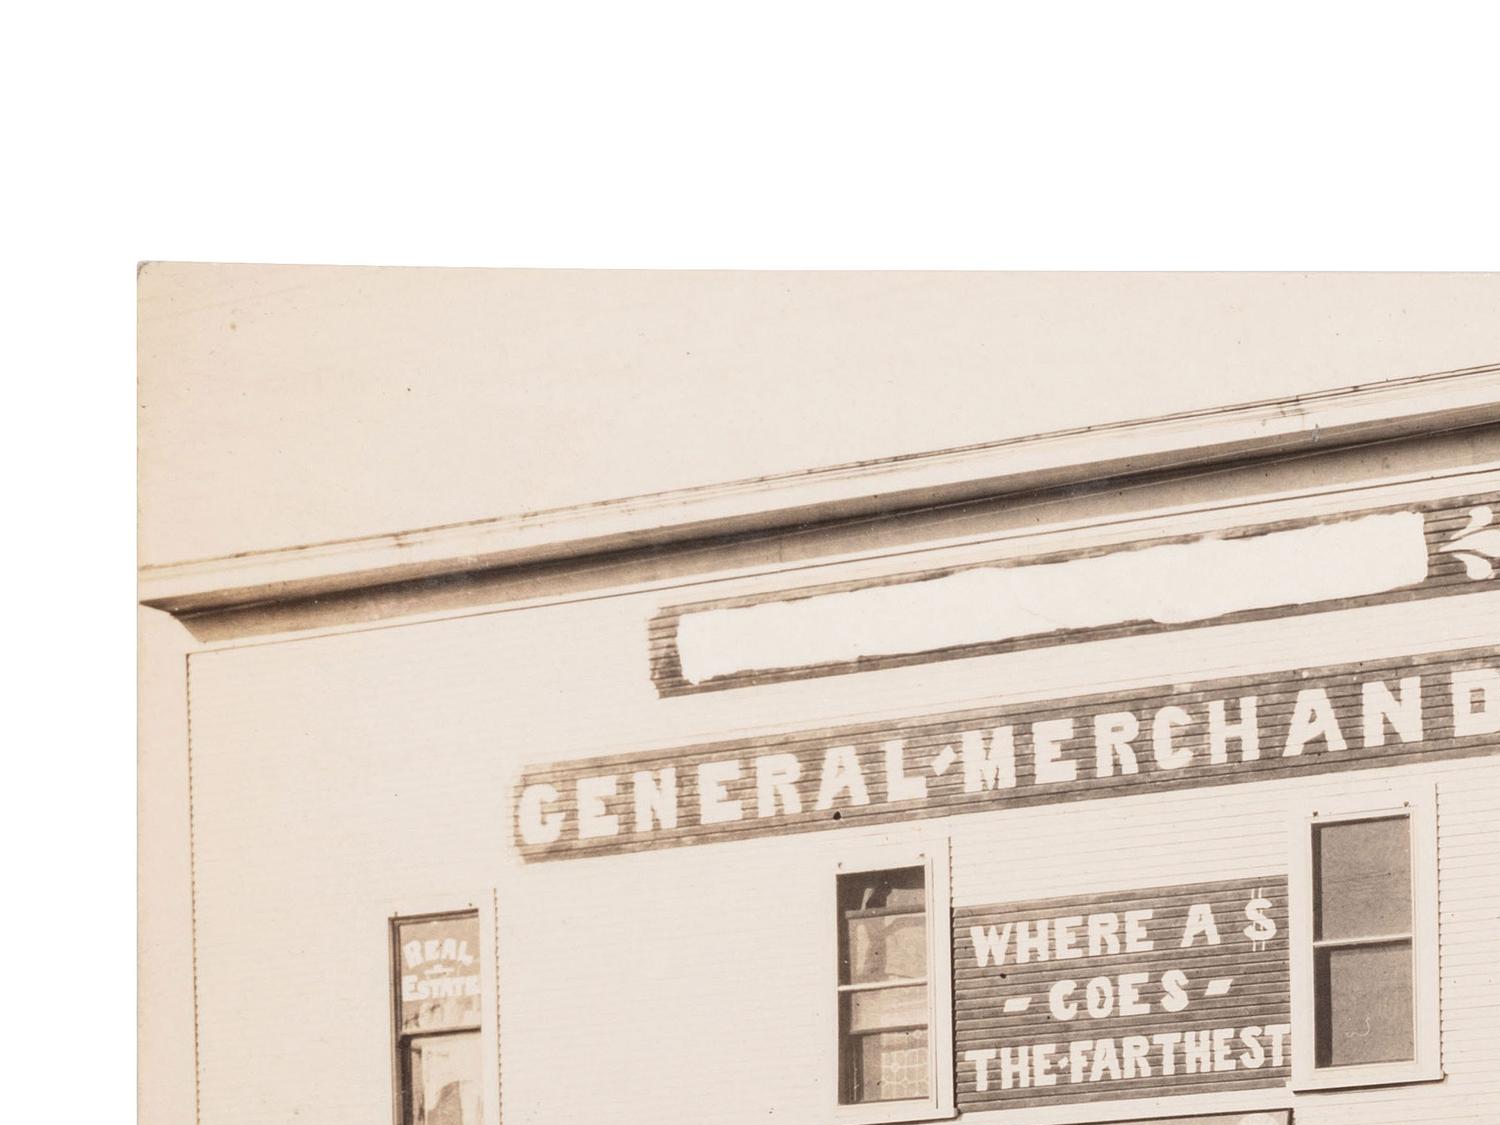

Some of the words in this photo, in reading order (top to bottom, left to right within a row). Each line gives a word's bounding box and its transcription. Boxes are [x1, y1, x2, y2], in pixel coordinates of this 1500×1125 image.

[518, 739, 928, 846] GENERAL
[402, 938, 474, 969] REAL
[970, 909, 1154, 967] WHERE
[1181, 903, 1221, 948] A
[402, 974, 480, 1002] ESTATE
[965, 1044, 1057, 1092] THE
[1070, 1023, 1291, 1084] FARTHEST
